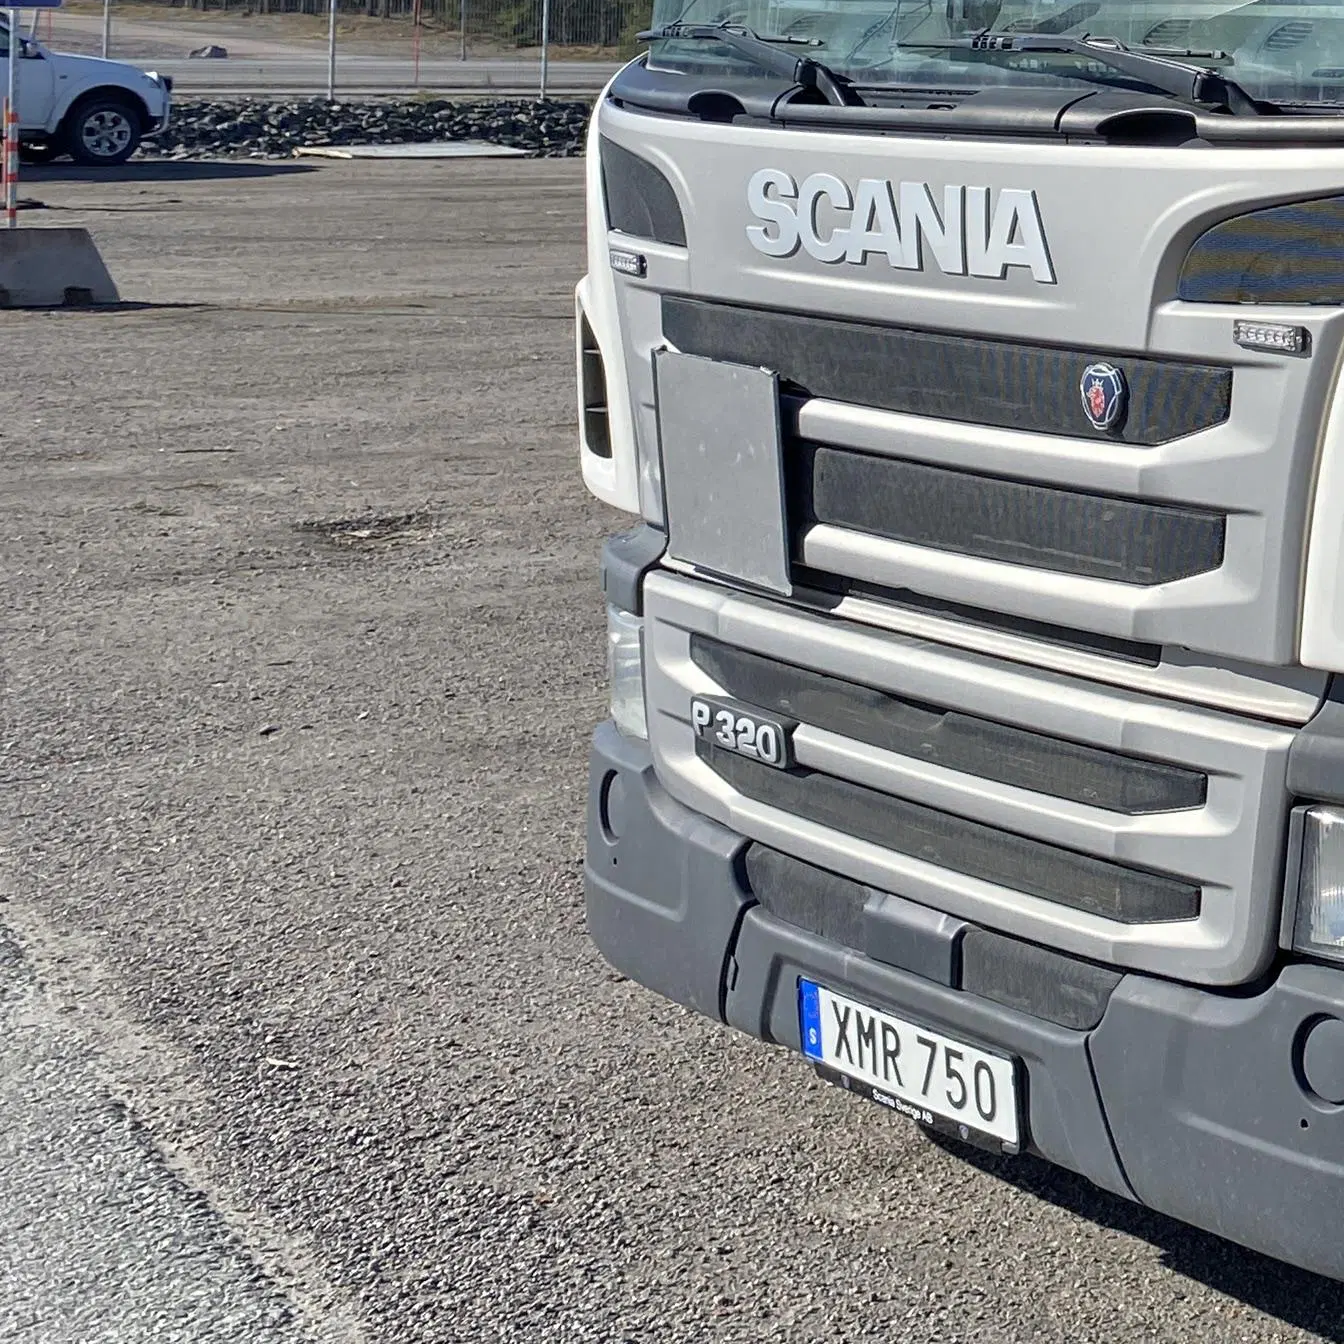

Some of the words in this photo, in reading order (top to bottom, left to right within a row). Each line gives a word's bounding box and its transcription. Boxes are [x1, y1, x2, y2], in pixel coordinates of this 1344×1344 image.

[746, 167, 1058, 285] SCANIA
[692, 701, 712, 737] P
[715, 710, 778, 763] 320
[808, 1027, 818, 1046] S
[831, 999, 904, 1088] XMR
[916, 1034, 998, 1123] 750
[872, 1088, 896, 1109] Scania
[895, 1098, 922, 1120] Sverige
[921, 1110, 934, 1125] AB
